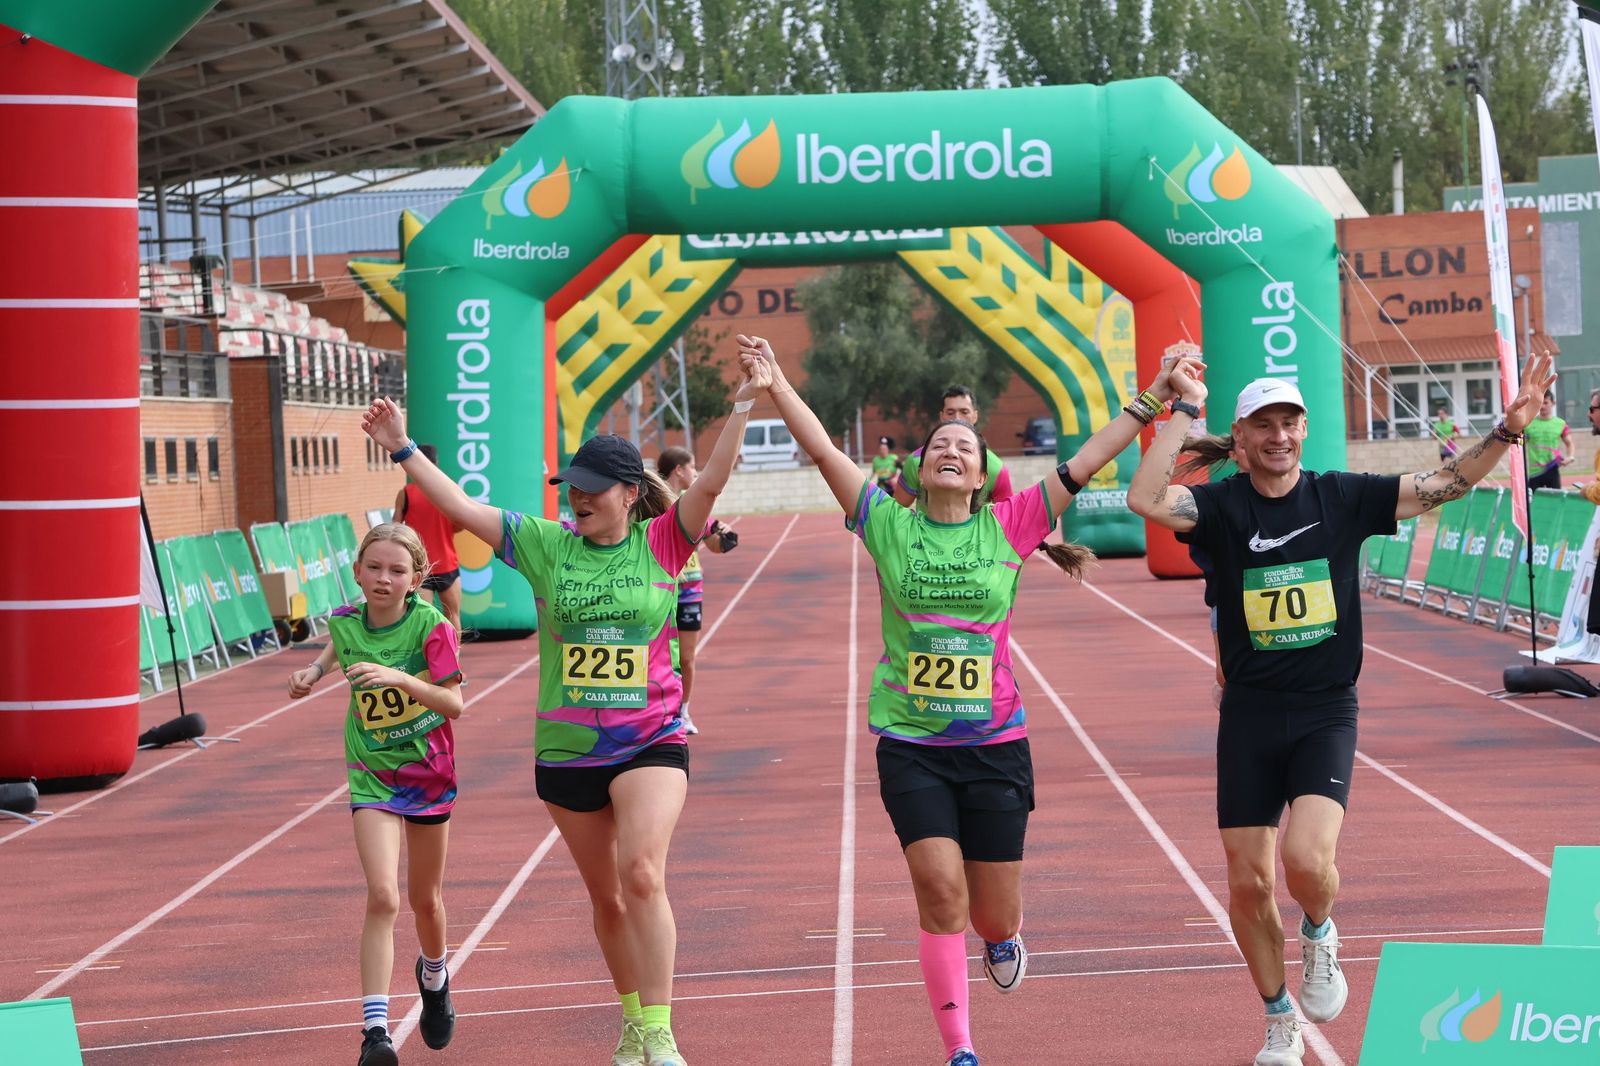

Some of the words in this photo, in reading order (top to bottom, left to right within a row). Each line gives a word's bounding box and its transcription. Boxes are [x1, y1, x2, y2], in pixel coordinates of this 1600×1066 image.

[796, 127, 1053, 184] Iberdrola
[1166, 223, 1263, 246] Iberdrola
[473, 238, 570, 260] Iberdrola
[757, 288, 804, 314] DE
[1378, 293, 1482, 325] Camba
[446, 299, 491, 503] berdrola
[912, 559, 931, 571] En
[935, 558, 995, 571] marcha
[563, 579, 582, 592] En
[911, 572, 967, 584] contra
[1265, 576, 1282, 584] CAJA
[1282, 572, 1305, 582] RURAL
[561, 594, 614, 607] contra
[908, 586, 925, 600] el
[928, 586, 991, 600] cáncer
[1260, 587, 1307, 622] 70
[561, 609, 574, 623] el
[578, 608, 640, 623] cáncer
[602, 633, 625, 641] RURAL
[1275, 633, 1299, 643] CAJA
[1301, 627, 1331, 641] RURAL
[568, 646, 634, 680] 225
[913, 654, 979, 690] 226
[585, 692, 608, 701] CAJA
[610, 692, 642, 702] RURAL
[930, 702, 952, 712] CAJA
[954, 703, 987, 713] RURAL
[389, 728, 412, 739] CAJA
[414, 712, 439, 732] RURAL
[1509, 1002, 1600, 1044] Iber
